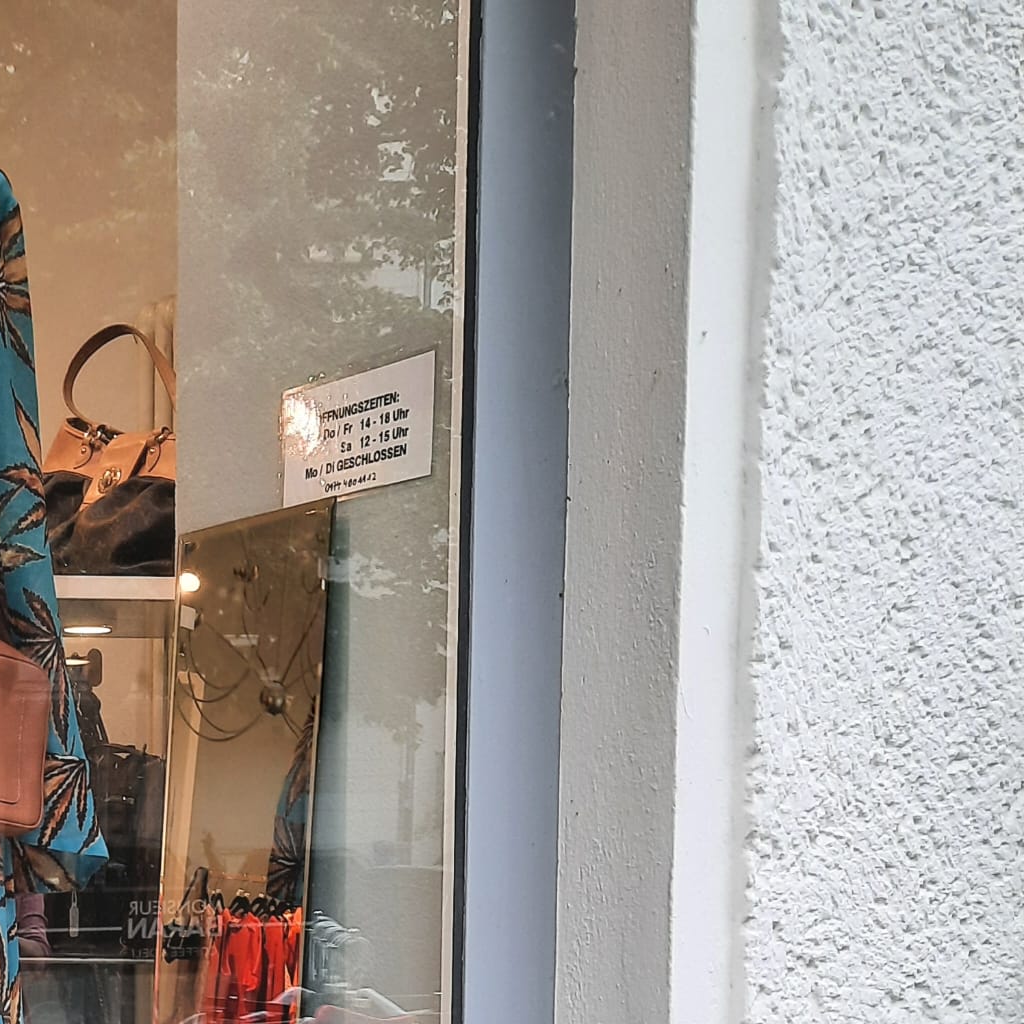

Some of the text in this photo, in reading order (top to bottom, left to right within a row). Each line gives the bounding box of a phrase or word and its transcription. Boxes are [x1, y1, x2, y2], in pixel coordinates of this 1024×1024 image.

[319, 391, 400, 423] FFNUNGSZEITEN:
[323, 428, 336, 441] Do
[343, 422, 353, 436] Fr
[360, 418, 371, 431] 14
[380, 411, 391, 425] 18
[392, 407, 410, 422] Uhr
[340, 441, 352, 454] Sa
[360, 435, 370, 449] 12
[379, 429, 390, 443] 15
[392, 426, 409, 441] Uhr
[304, 466, 318, 480] Mo
[336, 443, 408, 472] GESCHLOSSEN
